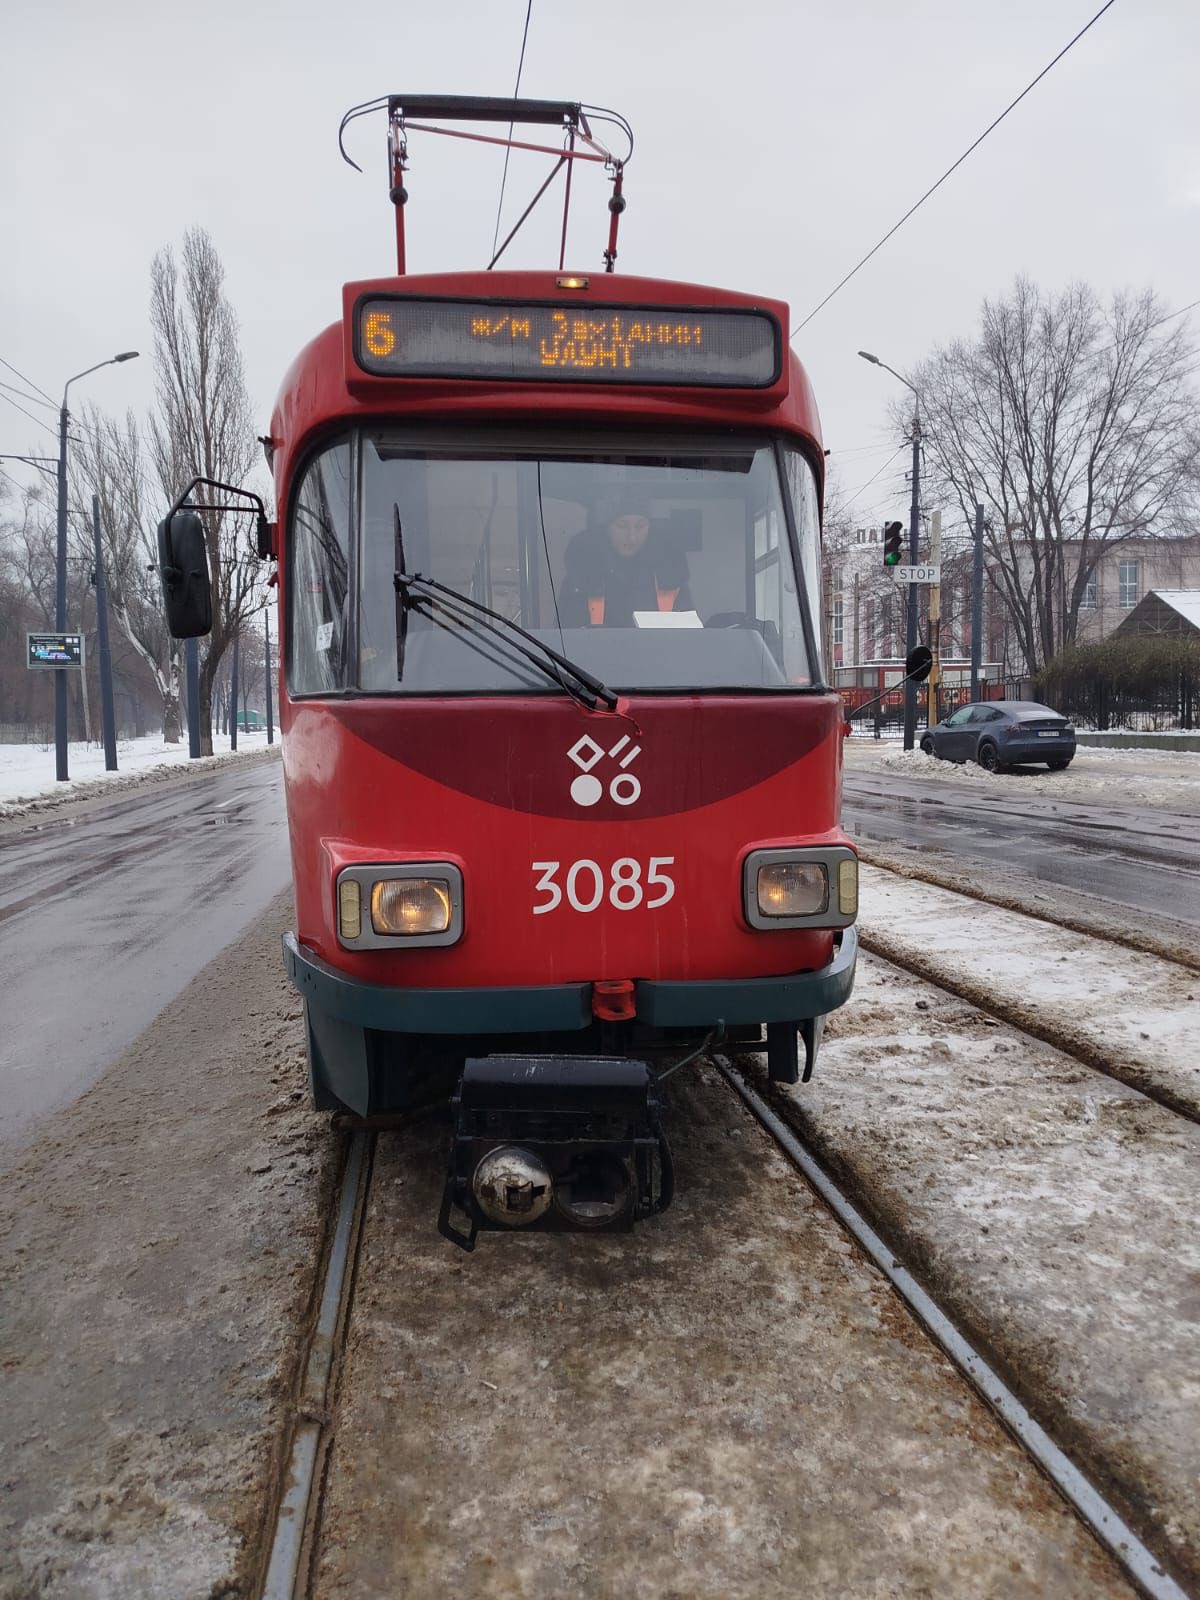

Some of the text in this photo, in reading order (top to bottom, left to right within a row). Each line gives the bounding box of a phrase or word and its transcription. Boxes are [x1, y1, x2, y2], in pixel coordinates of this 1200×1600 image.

[367, 313, 395, 357] 6
[899, 568, 936, 580] STOP
[531, 856, 676, 915] 3085
